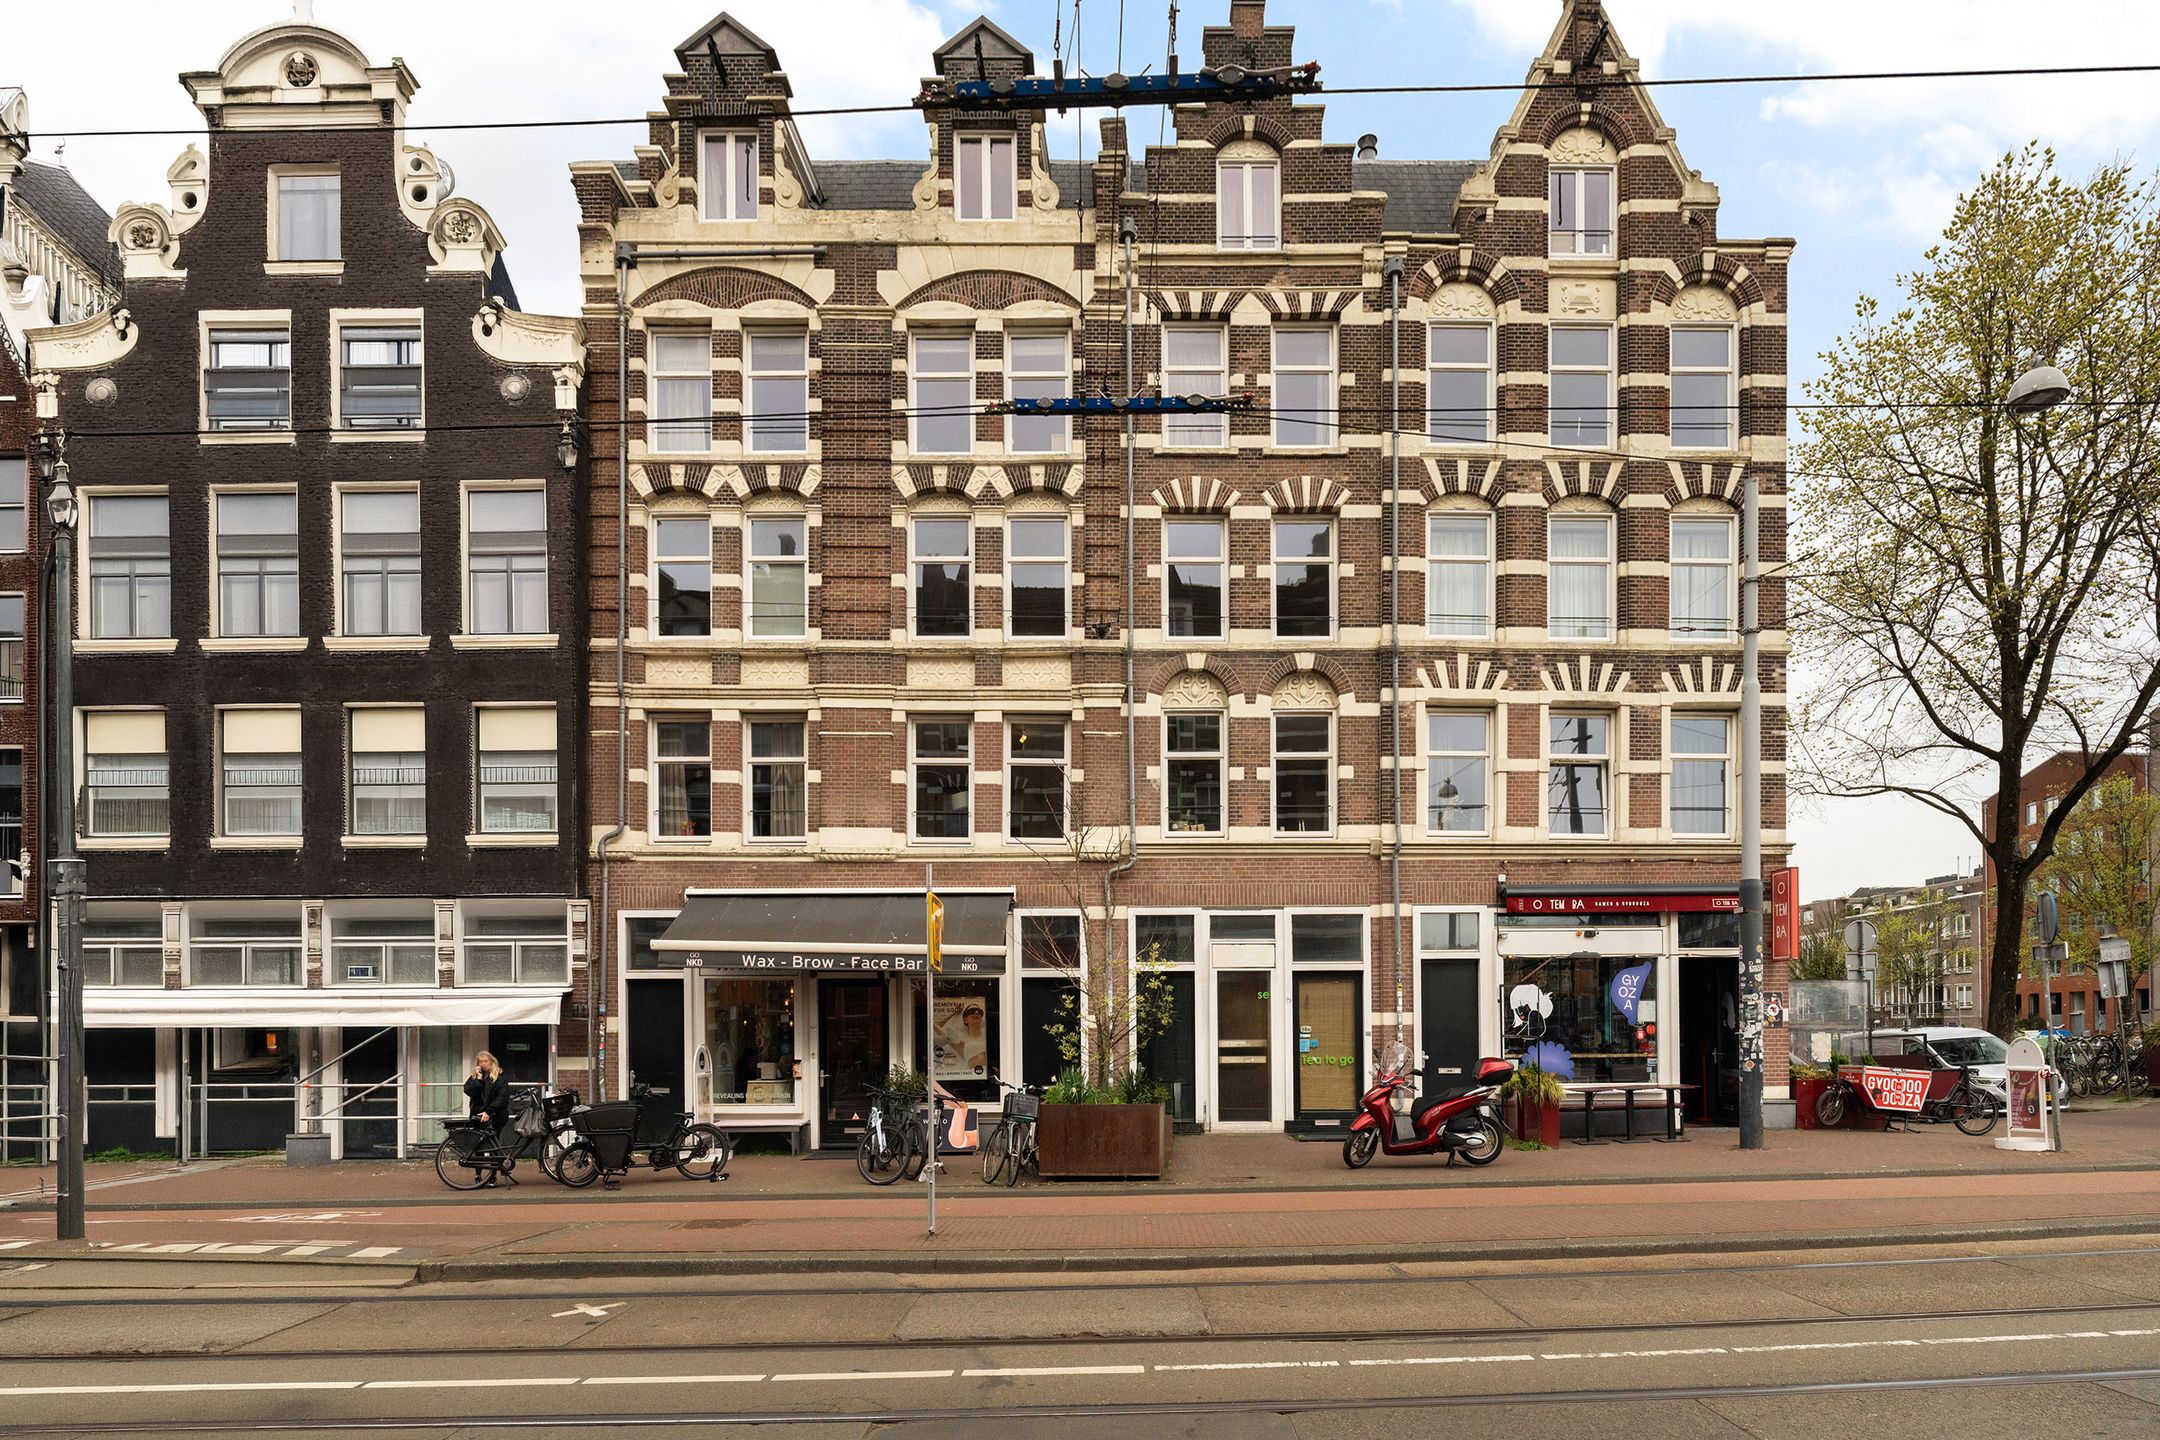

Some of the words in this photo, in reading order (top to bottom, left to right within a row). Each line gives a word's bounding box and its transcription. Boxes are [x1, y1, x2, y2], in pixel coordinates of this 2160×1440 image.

[1777, 881, 1786, 895] O
[1532, 899, 1543, 910] O
[1550, 899, 1565, 910] TEM
[1572, 899, 1585, 910] BA
[1775, 903, 1787, 916] TEM
[1776, 925, 1787, 938] BA
[686, 959, 704, 967] NKD
[742, 955, 775, 967] Wax
[792, 955, 834, 968] Brow
[851, 956, 890, 970] Face
[895, 957, 924, 970] Bar
[961, 963, 978, 971] NKD
[1621, 975, 1640, 986] GY
[1618, 987, 1637, 998] OZ
[1624, 1000, 1633, 1010] A
[1302, 1055, 1321, 1064] Tea
[1325, 1055, 1336, 1064] to
[1339, 1056, 1354, 1066] go
